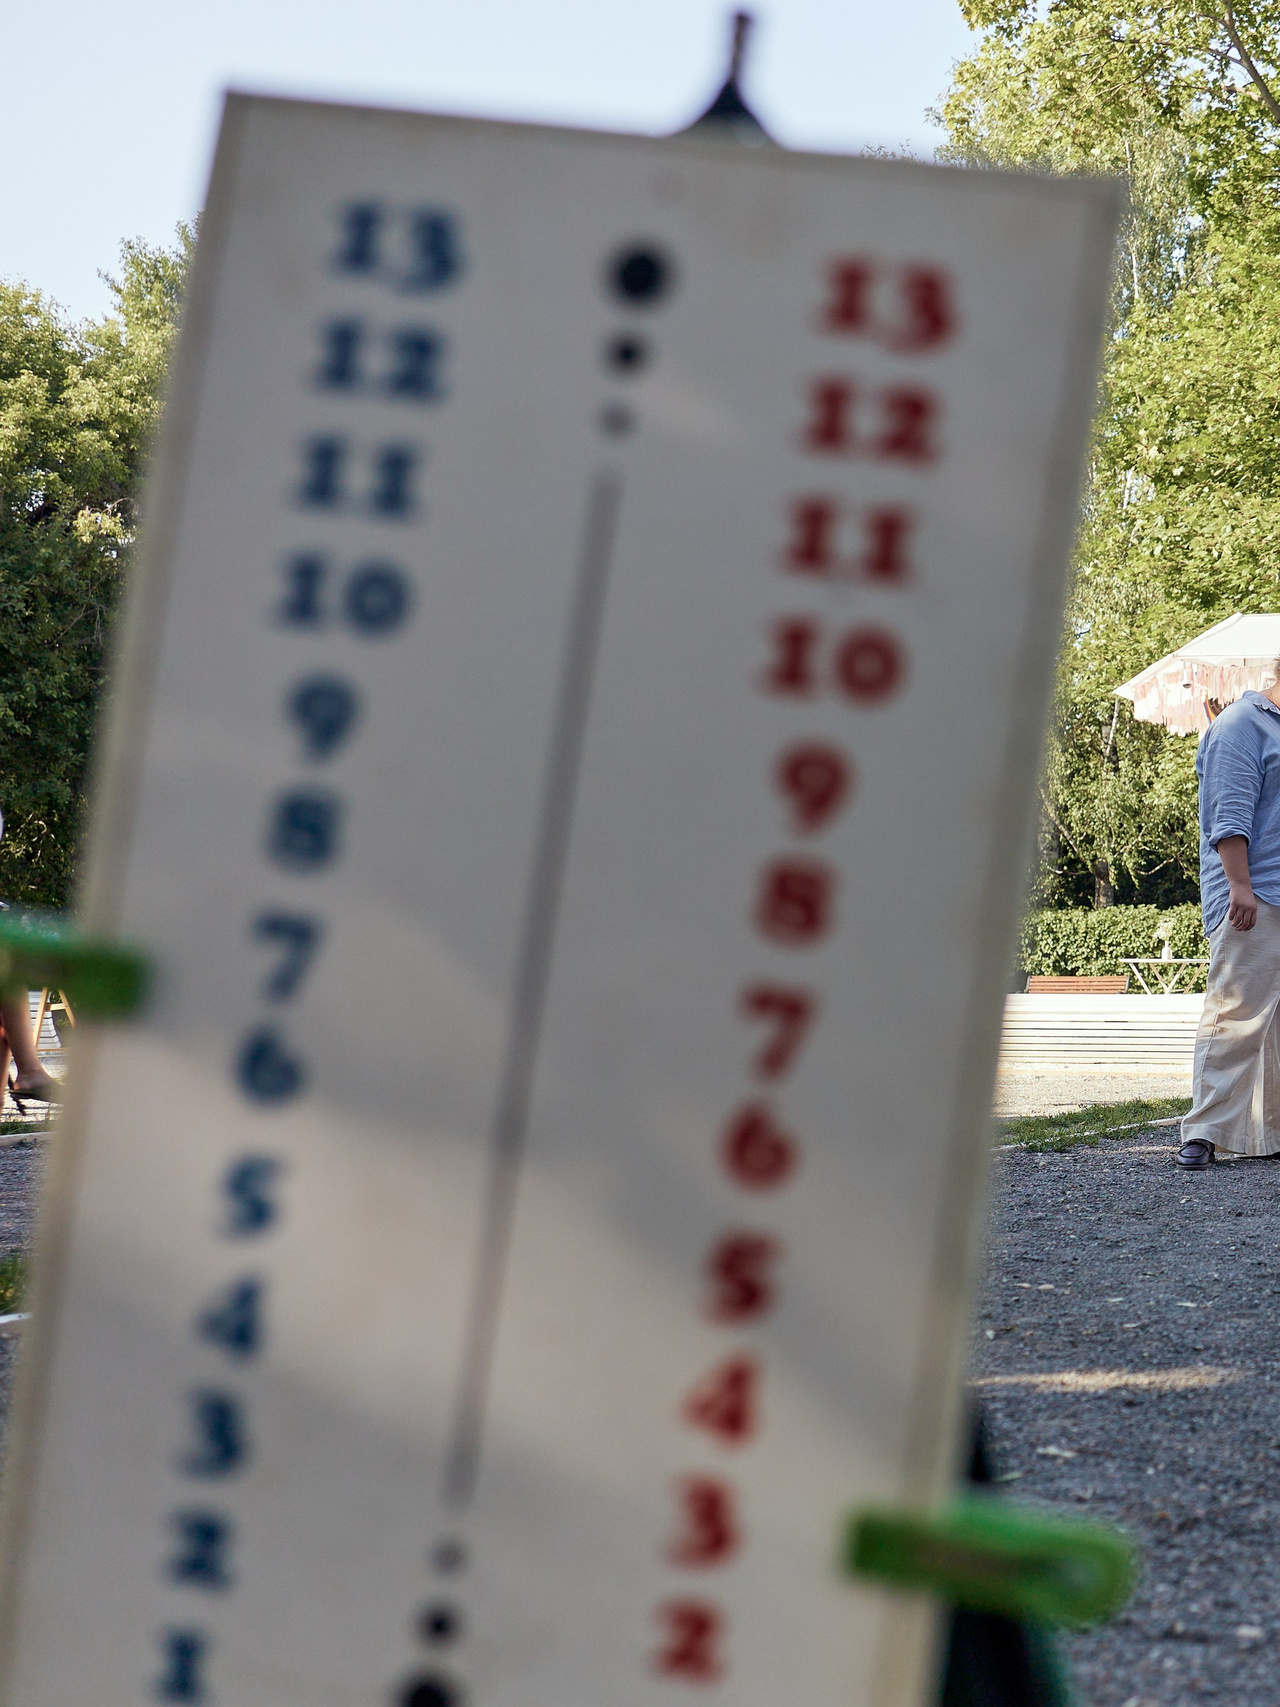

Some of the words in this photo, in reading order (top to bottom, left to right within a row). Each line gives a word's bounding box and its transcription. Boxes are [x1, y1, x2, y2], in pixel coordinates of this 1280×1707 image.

[332, 198, 469, 297] 13
[822, 257, 958, 354] 13
[315, 315, 448, 404] 12
[803, 377, 940, 467] 12
[295, 431, 418, 522] 11
[783, 496, 912, 586] 11
[276, 550, 411, 637] 10
[766, 617, 905, 706] 10
[282, 670, 363, 764] 9
[270, 789, 339, 867] 8
[773, 741, 854, 835] 9
[756, 859, 833, 945] 8
[247, 907, 325, 1008] 7
[233, 1023, 308, 1105] 6
[738, 981, 820, 1083] 7
[718, 1104, 800, 1194] 6
[220, 1153, 279, 1240] 5
[195, 1276, 266, 1364] 4
[705, 1232, 778, 1328] 5
[187, 1388, 247, 1482] 3
[682, 1354, 760, 1450] 4
[168, 1510, 232, 1591] 2
[676, 1476, 742, 1570] 3
[155, 1627, 208, 1707] 1
[656, 1599, 723, 1684] 2
